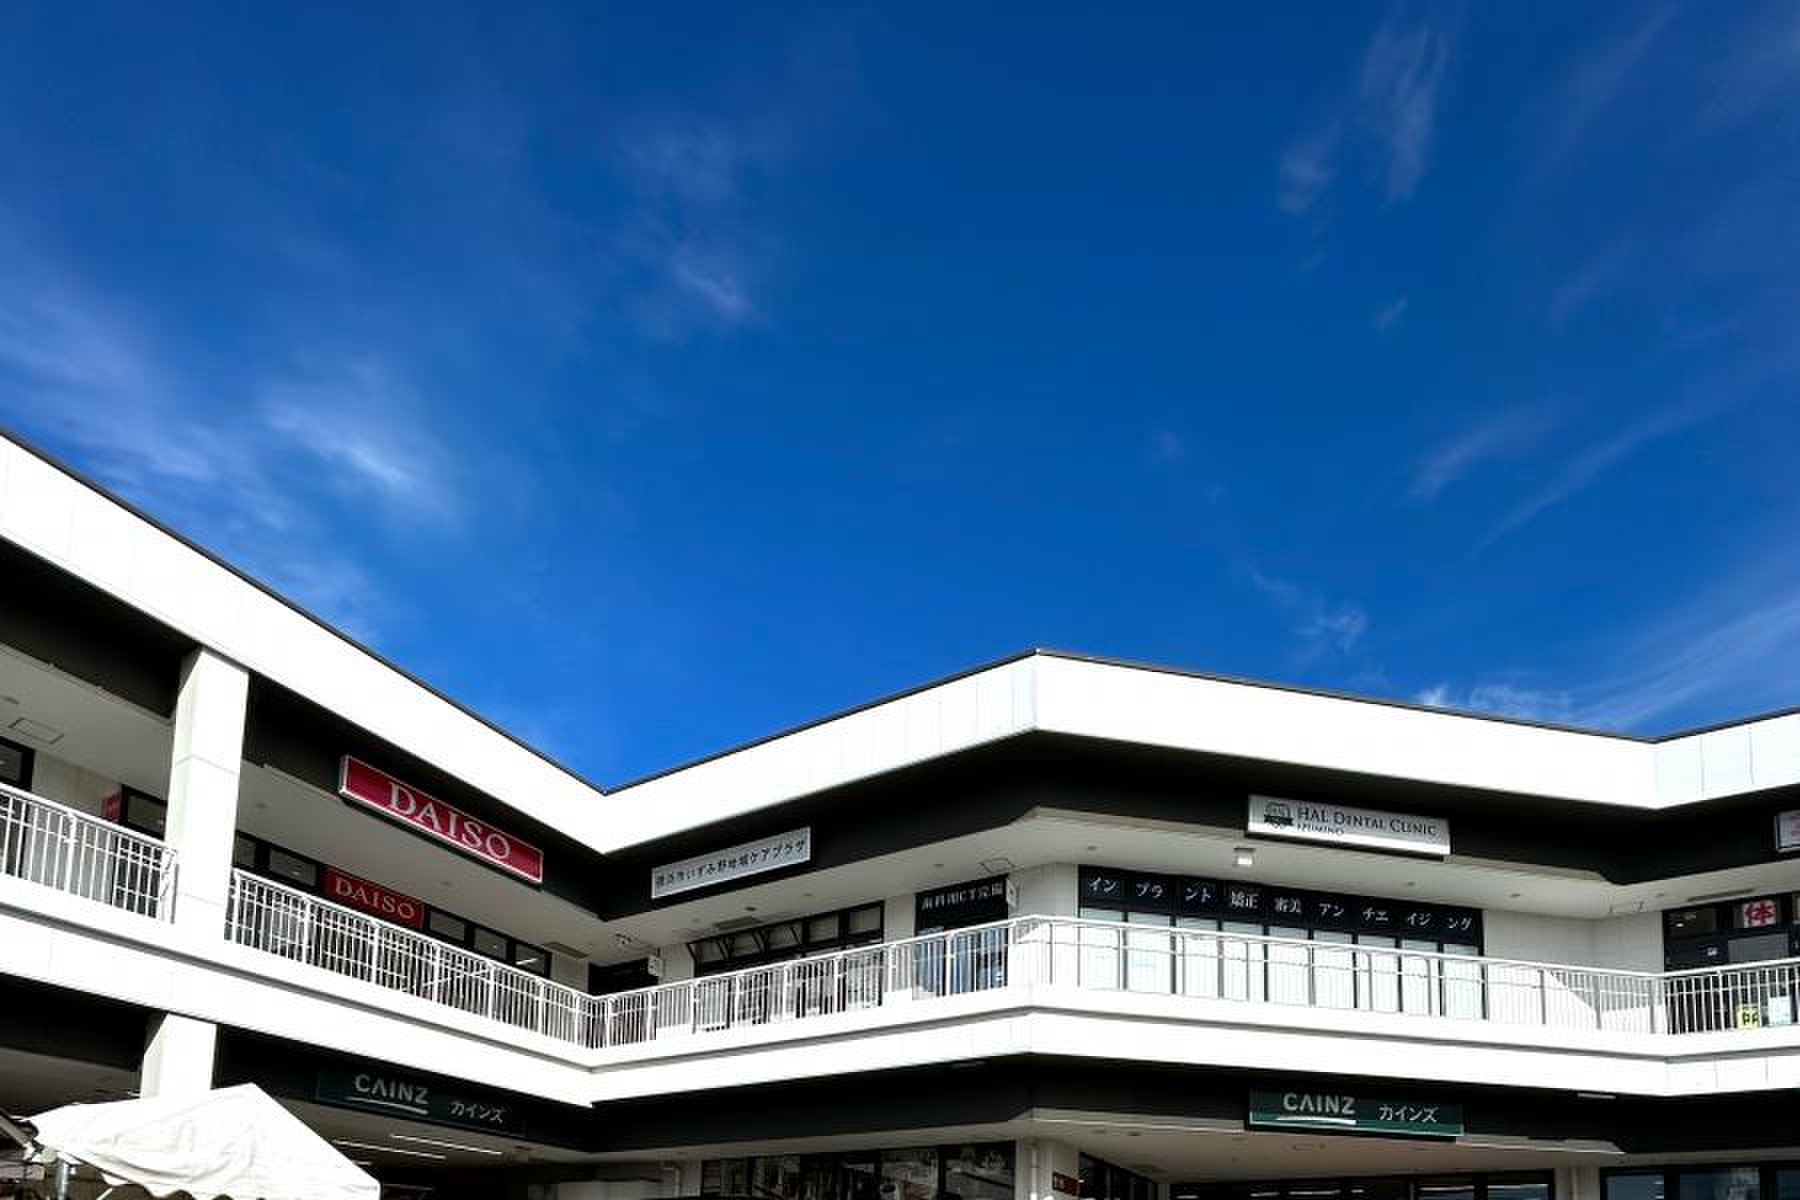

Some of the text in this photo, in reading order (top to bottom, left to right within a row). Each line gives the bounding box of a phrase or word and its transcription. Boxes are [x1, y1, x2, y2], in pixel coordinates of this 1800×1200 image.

[388, 780, 511, 861] DAISO
[1297, 806, 1329, 824] HAL
[1390, 818, 1437, 837] CLINIC
[334, 877, 415, 919] DAISO
[354, 1074, 504, 1123] CAINZ カインズ
[1282, 1092, 1440, 1123] CAINZ カインズ
